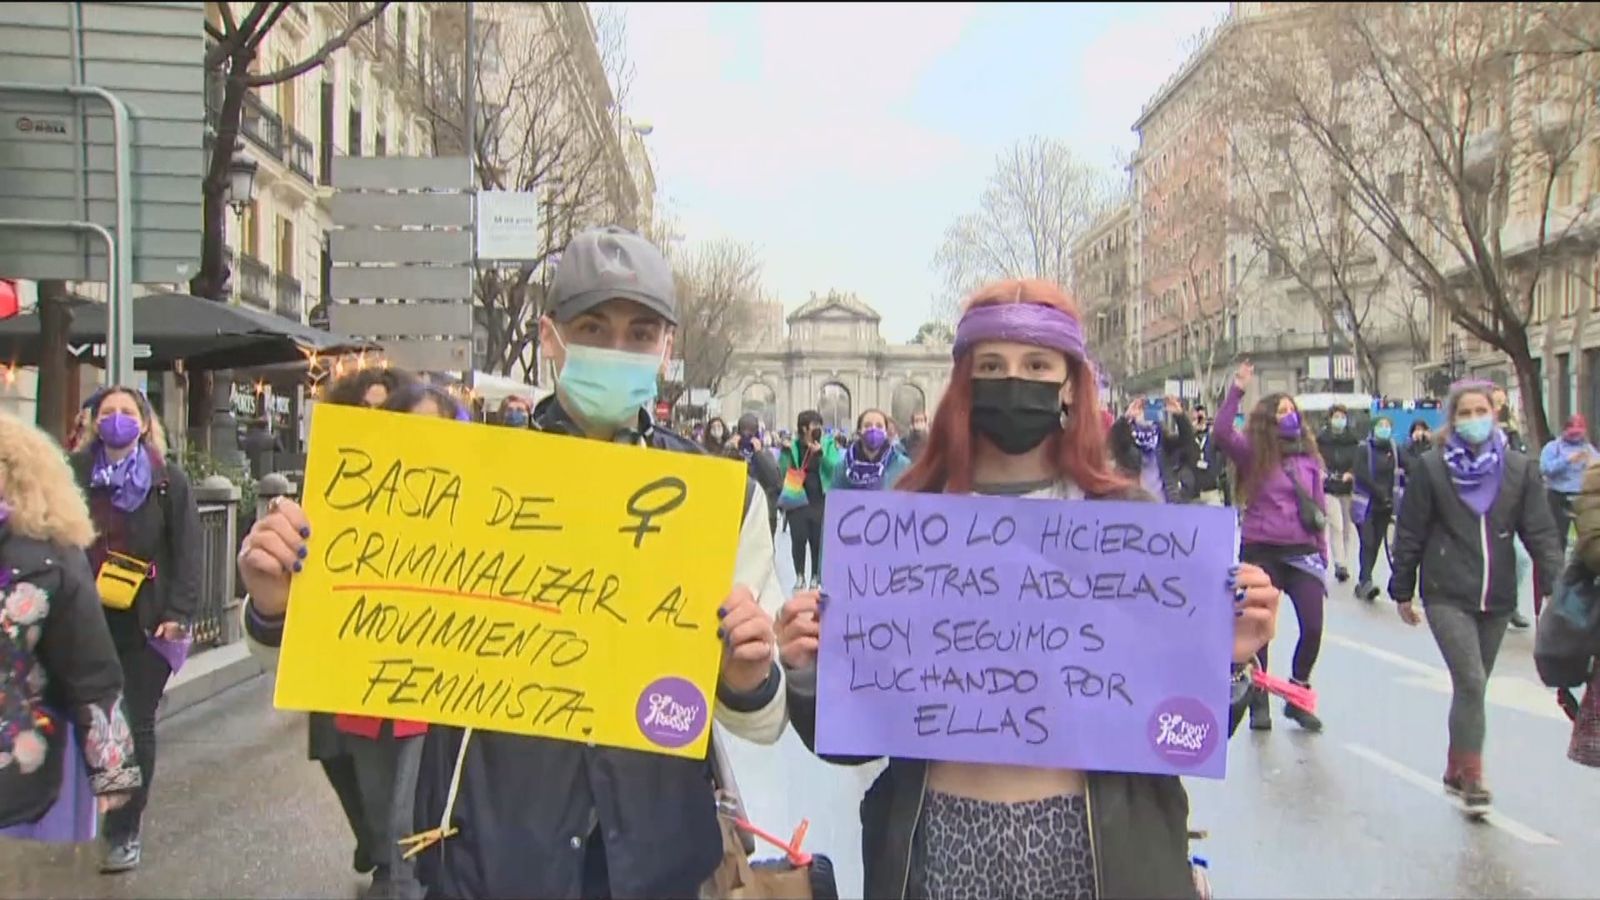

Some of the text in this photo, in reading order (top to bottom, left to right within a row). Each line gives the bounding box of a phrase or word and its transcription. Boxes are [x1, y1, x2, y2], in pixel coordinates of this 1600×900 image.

[325, 448, 563, 530] BASTA DE
[837, 505, 949, 556] COMO
[966, 514, 1017, 547] LO
[647, 586, 699, 629] AL
[847, 565, 1197, 617] NUESTRAS ABUELAS,
[338, 595, 589, 667] MOVIMIENTO
[843, 615, 911, 656] HOY
[850, 662, 1134, 706] LUCHANDO POR
[914, 704, 1049, 745] ELLAS
